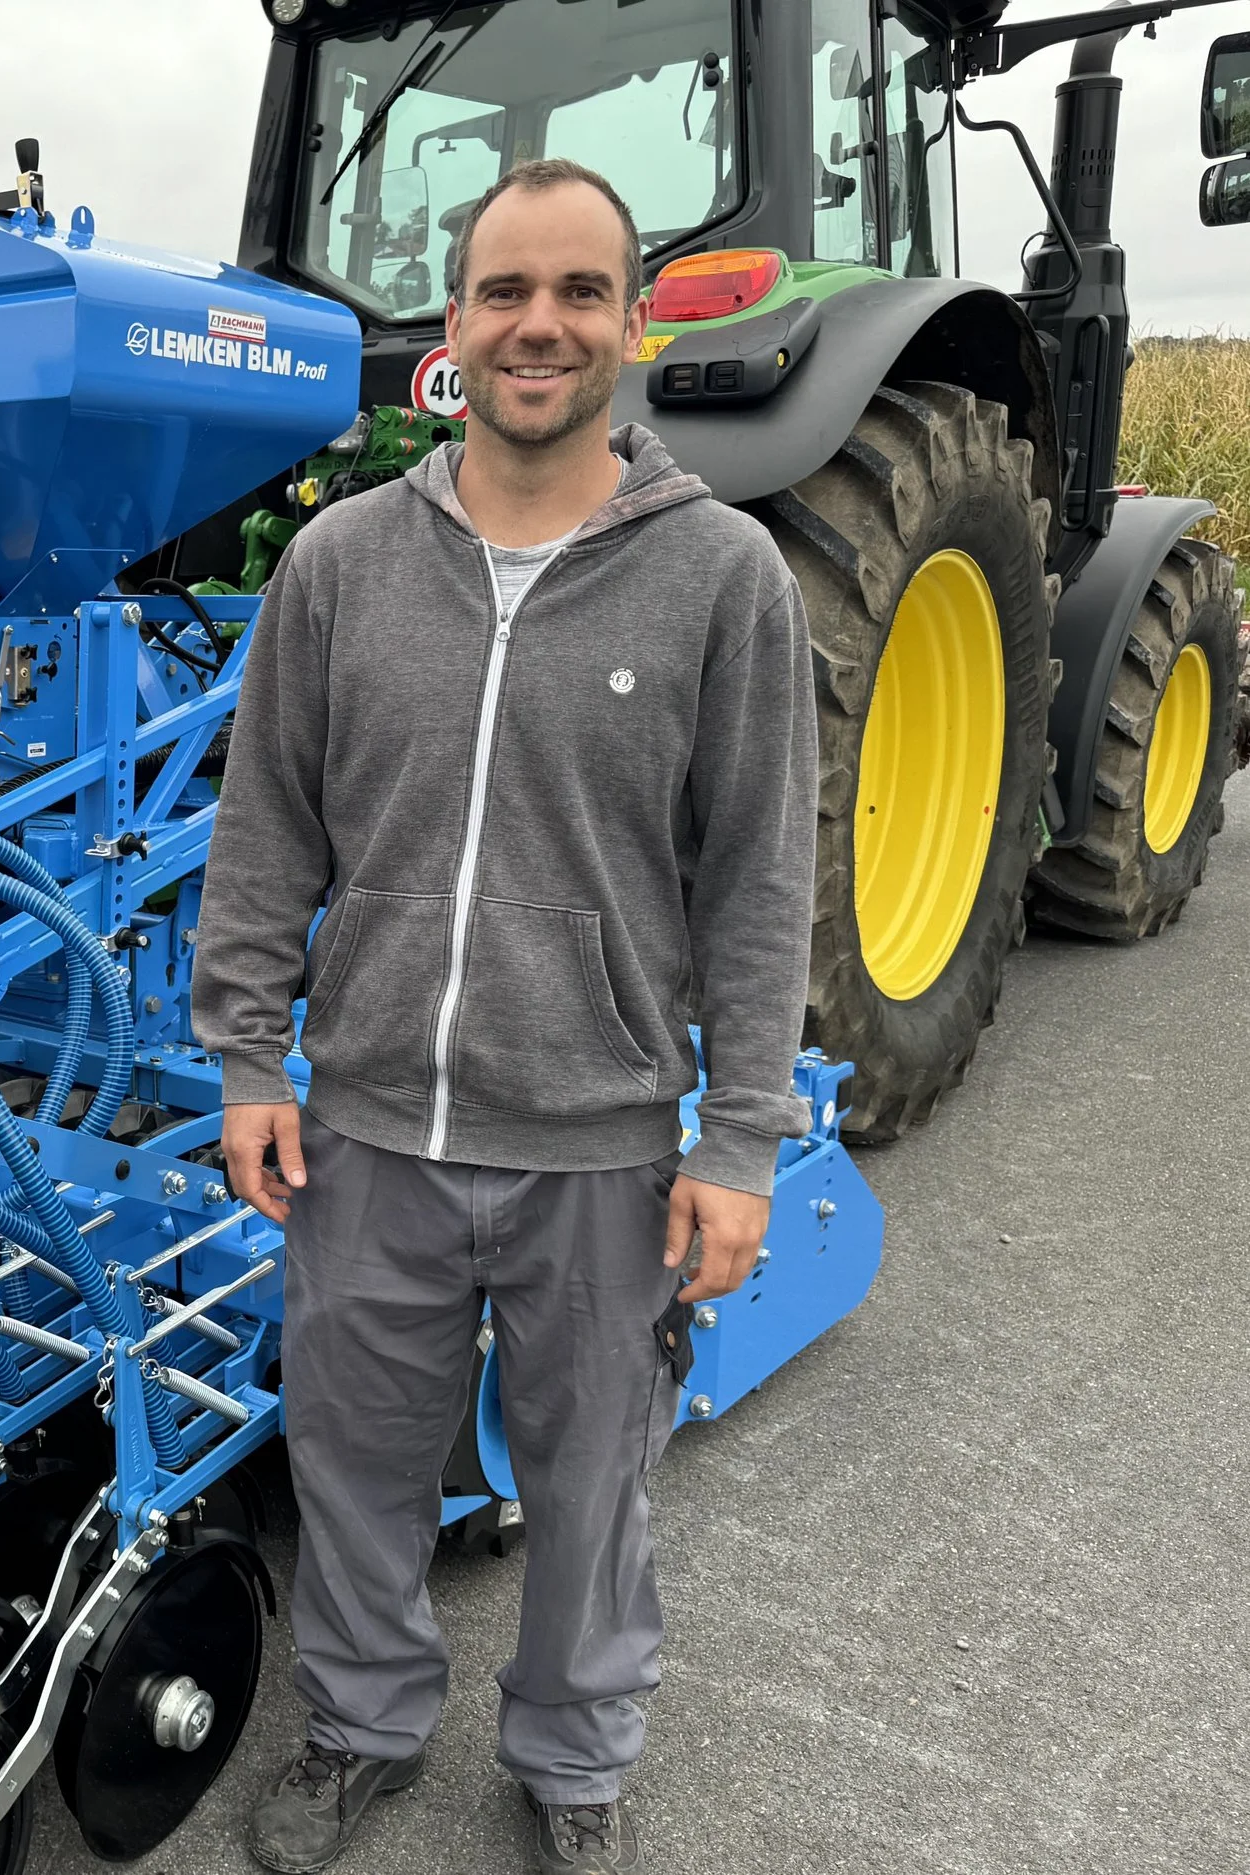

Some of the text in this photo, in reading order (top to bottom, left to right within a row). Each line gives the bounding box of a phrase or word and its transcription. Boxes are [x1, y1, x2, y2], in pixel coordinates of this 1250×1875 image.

[221, 316, 265, 332] BACHMANN
[151, 327, 328, 381] LEMKEN BLM Profi
[429, 369, 463, 401] 40
